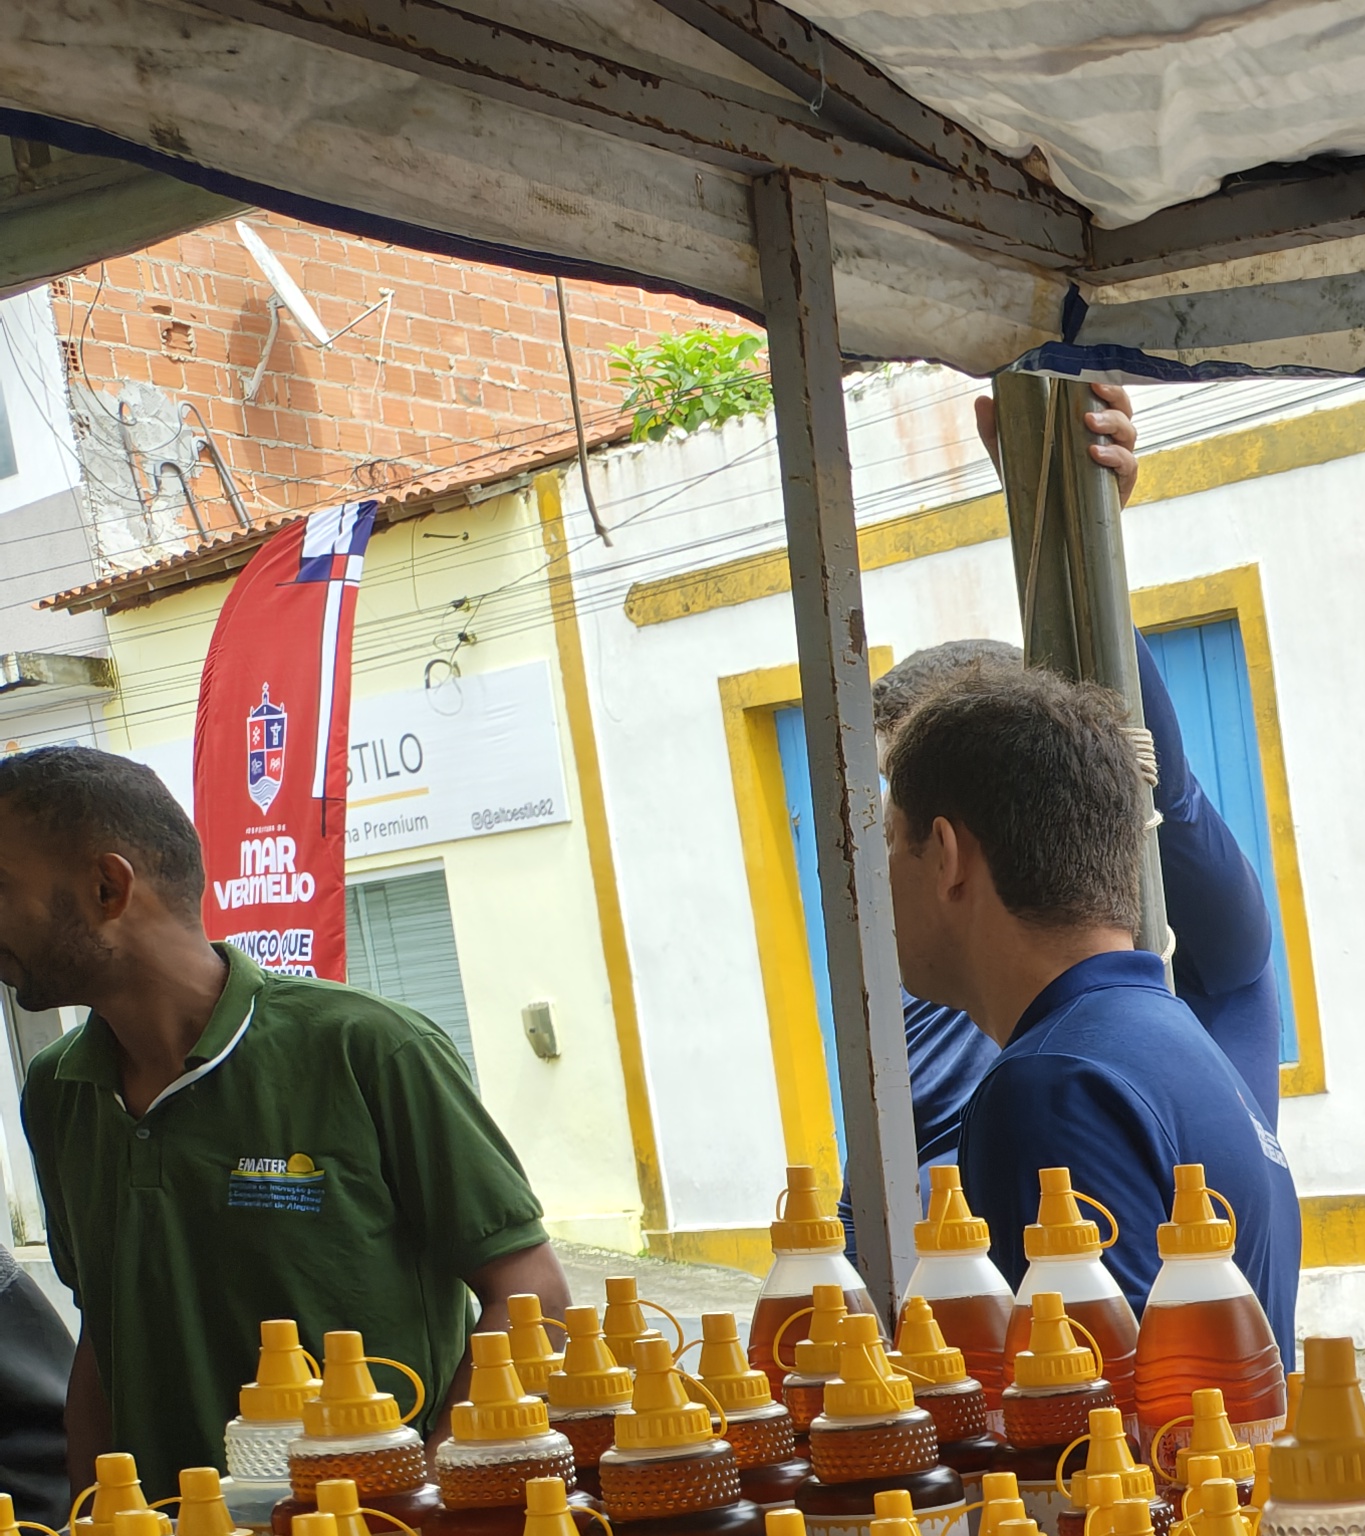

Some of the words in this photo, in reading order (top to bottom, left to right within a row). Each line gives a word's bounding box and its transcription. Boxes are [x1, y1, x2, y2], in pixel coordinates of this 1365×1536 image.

[364, 814, 429, 841] Premium
[240, 836, 296, 877] MAR
[281, 929, 313, 962] QUE
[237, 1157, 287, 1173] EMATER
